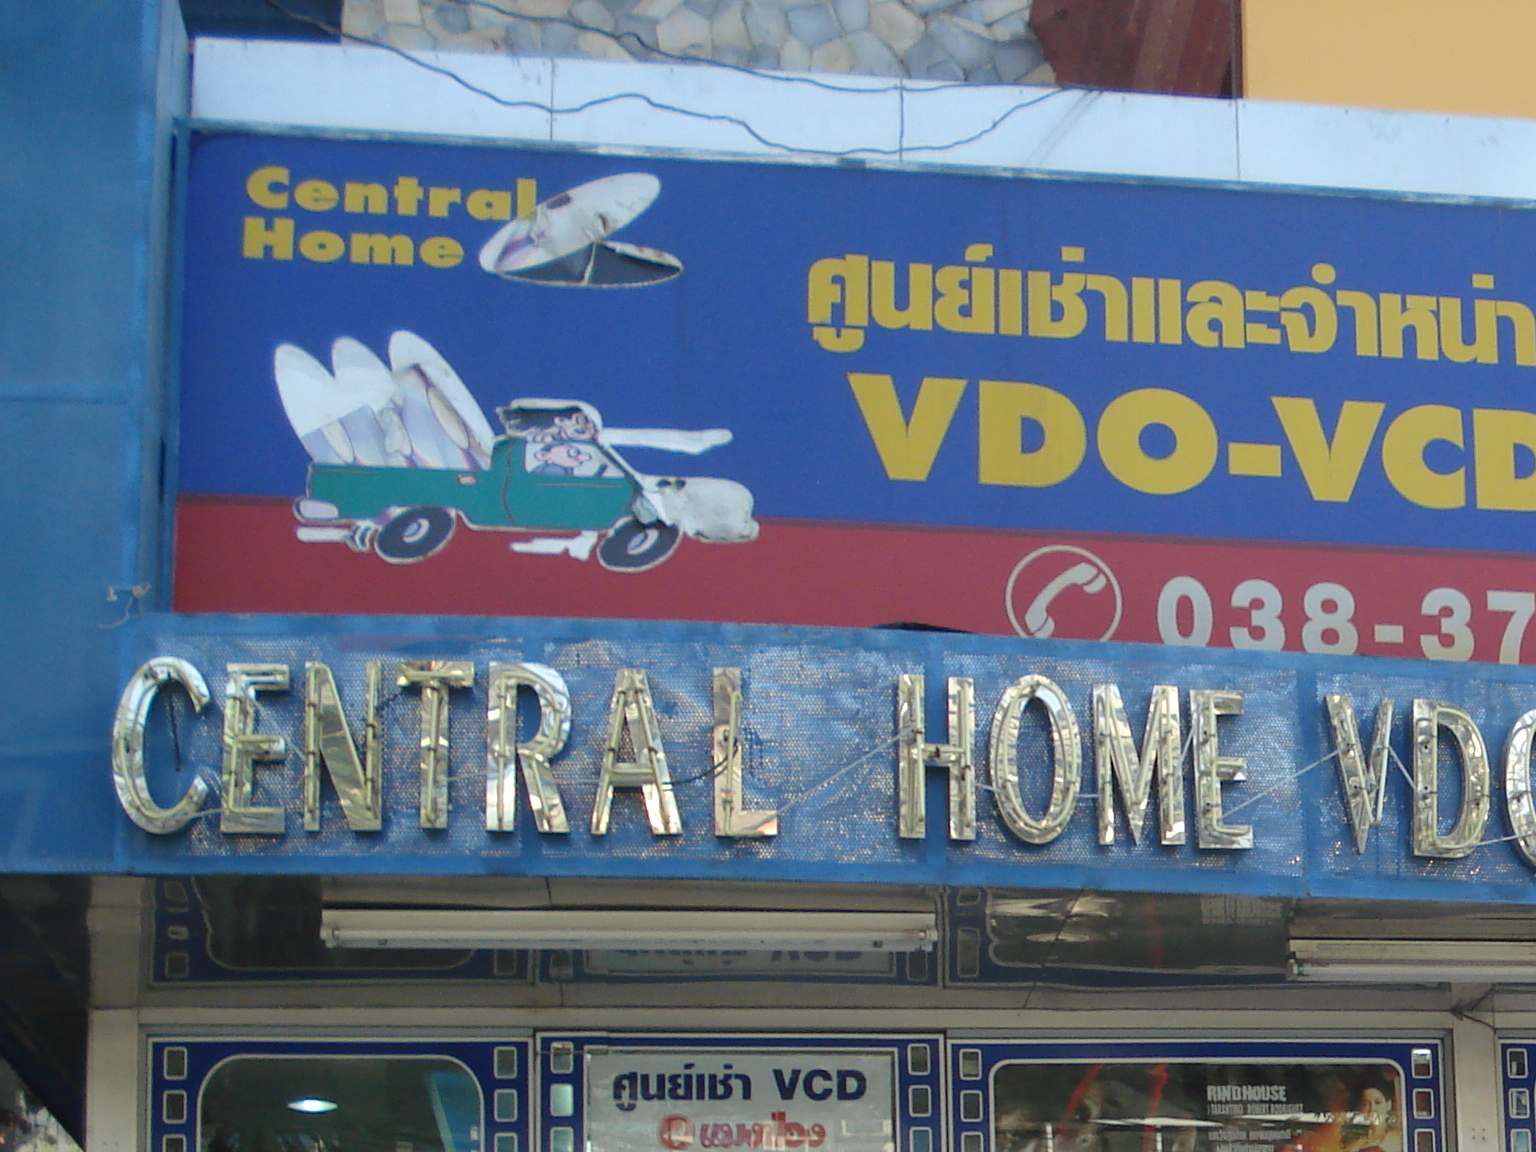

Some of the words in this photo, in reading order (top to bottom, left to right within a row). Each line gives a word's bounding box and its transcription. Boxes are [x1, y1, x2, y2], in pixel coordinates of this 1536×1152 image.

[245, 166, 538, 221] Central
[242, 217, 464, 268] Home
[111, 655, 779, 838] CENTRAL
[896, 673, 1255, 852] HOME
[613, 1063, 752, 1111] ศูนย์เช่า
[772, 1066, 868, 1102] VCD
[1206, 1084, 1287, 1102] RINDHOUSE
